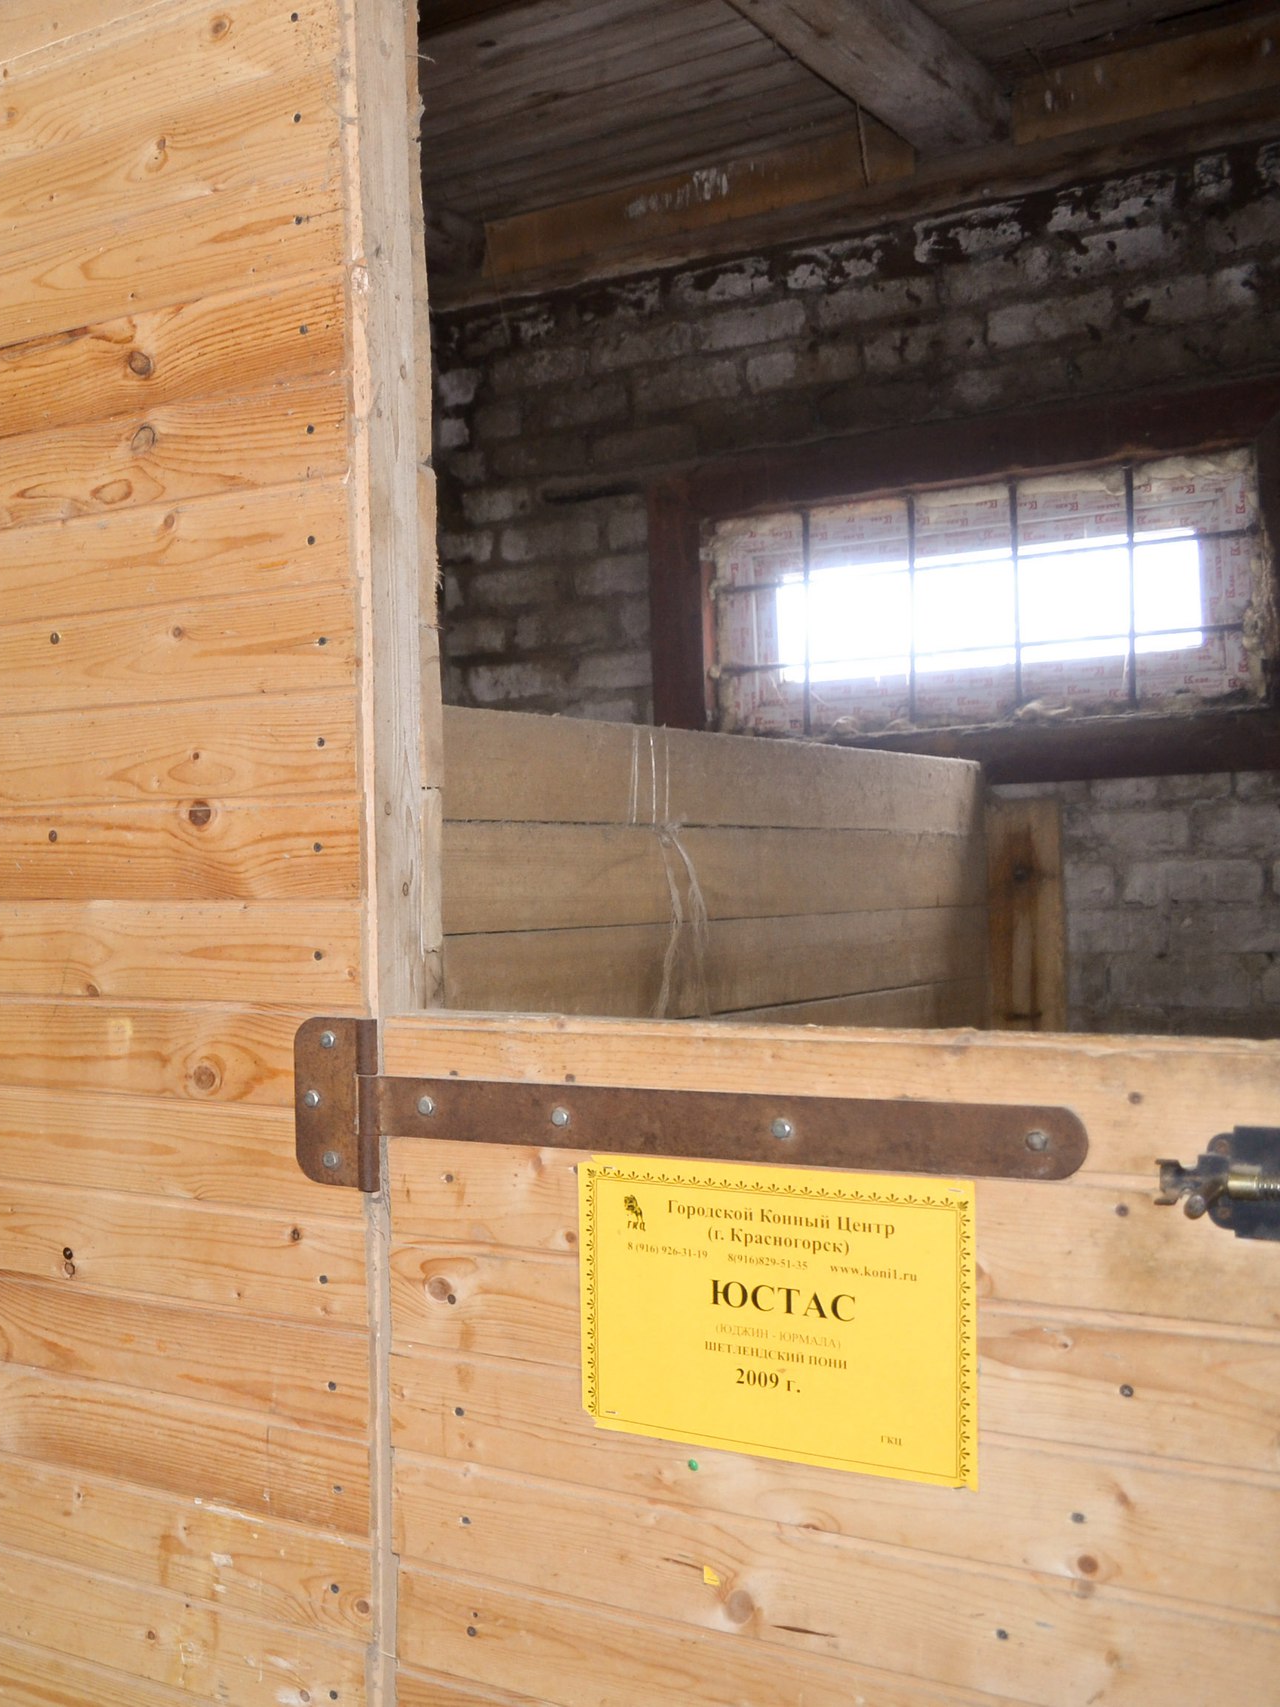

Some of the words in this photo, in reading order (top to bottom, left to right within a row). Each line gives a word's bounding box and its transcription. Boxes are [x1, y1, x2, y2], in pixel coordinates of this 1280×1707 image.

[668, 1199, 754, 1222] Городской
[760, 1208, 831, 1230] Конный
[837, 1216, 896, 1239] Центр
[627, 1241, 634, 1250] 8
[635, 1243, 659, 1254] (916)
[661, 1245, 708, 1259] 926-31-19
[707, 1226, 725, 1242] (г.
[730, 1227, 850, 1256] Красногорск)
[829, 1264, 918, 1282] www.koni1.ru
[710, 1278, 856, 1323] ЮСТАС
[714, 1322, 769, 1340] (ЮДЖИН
[779, 1331, 841, 1350] ЮРМАЛА)
[704, 1340, 805, 1364] ШЕТЛЕНДСКИЙ
[808, 1355, 848, 1370] ПОНИ
[735, 1367, 780, 1390] 2009
[786, 1379, 801, 1393] г.
